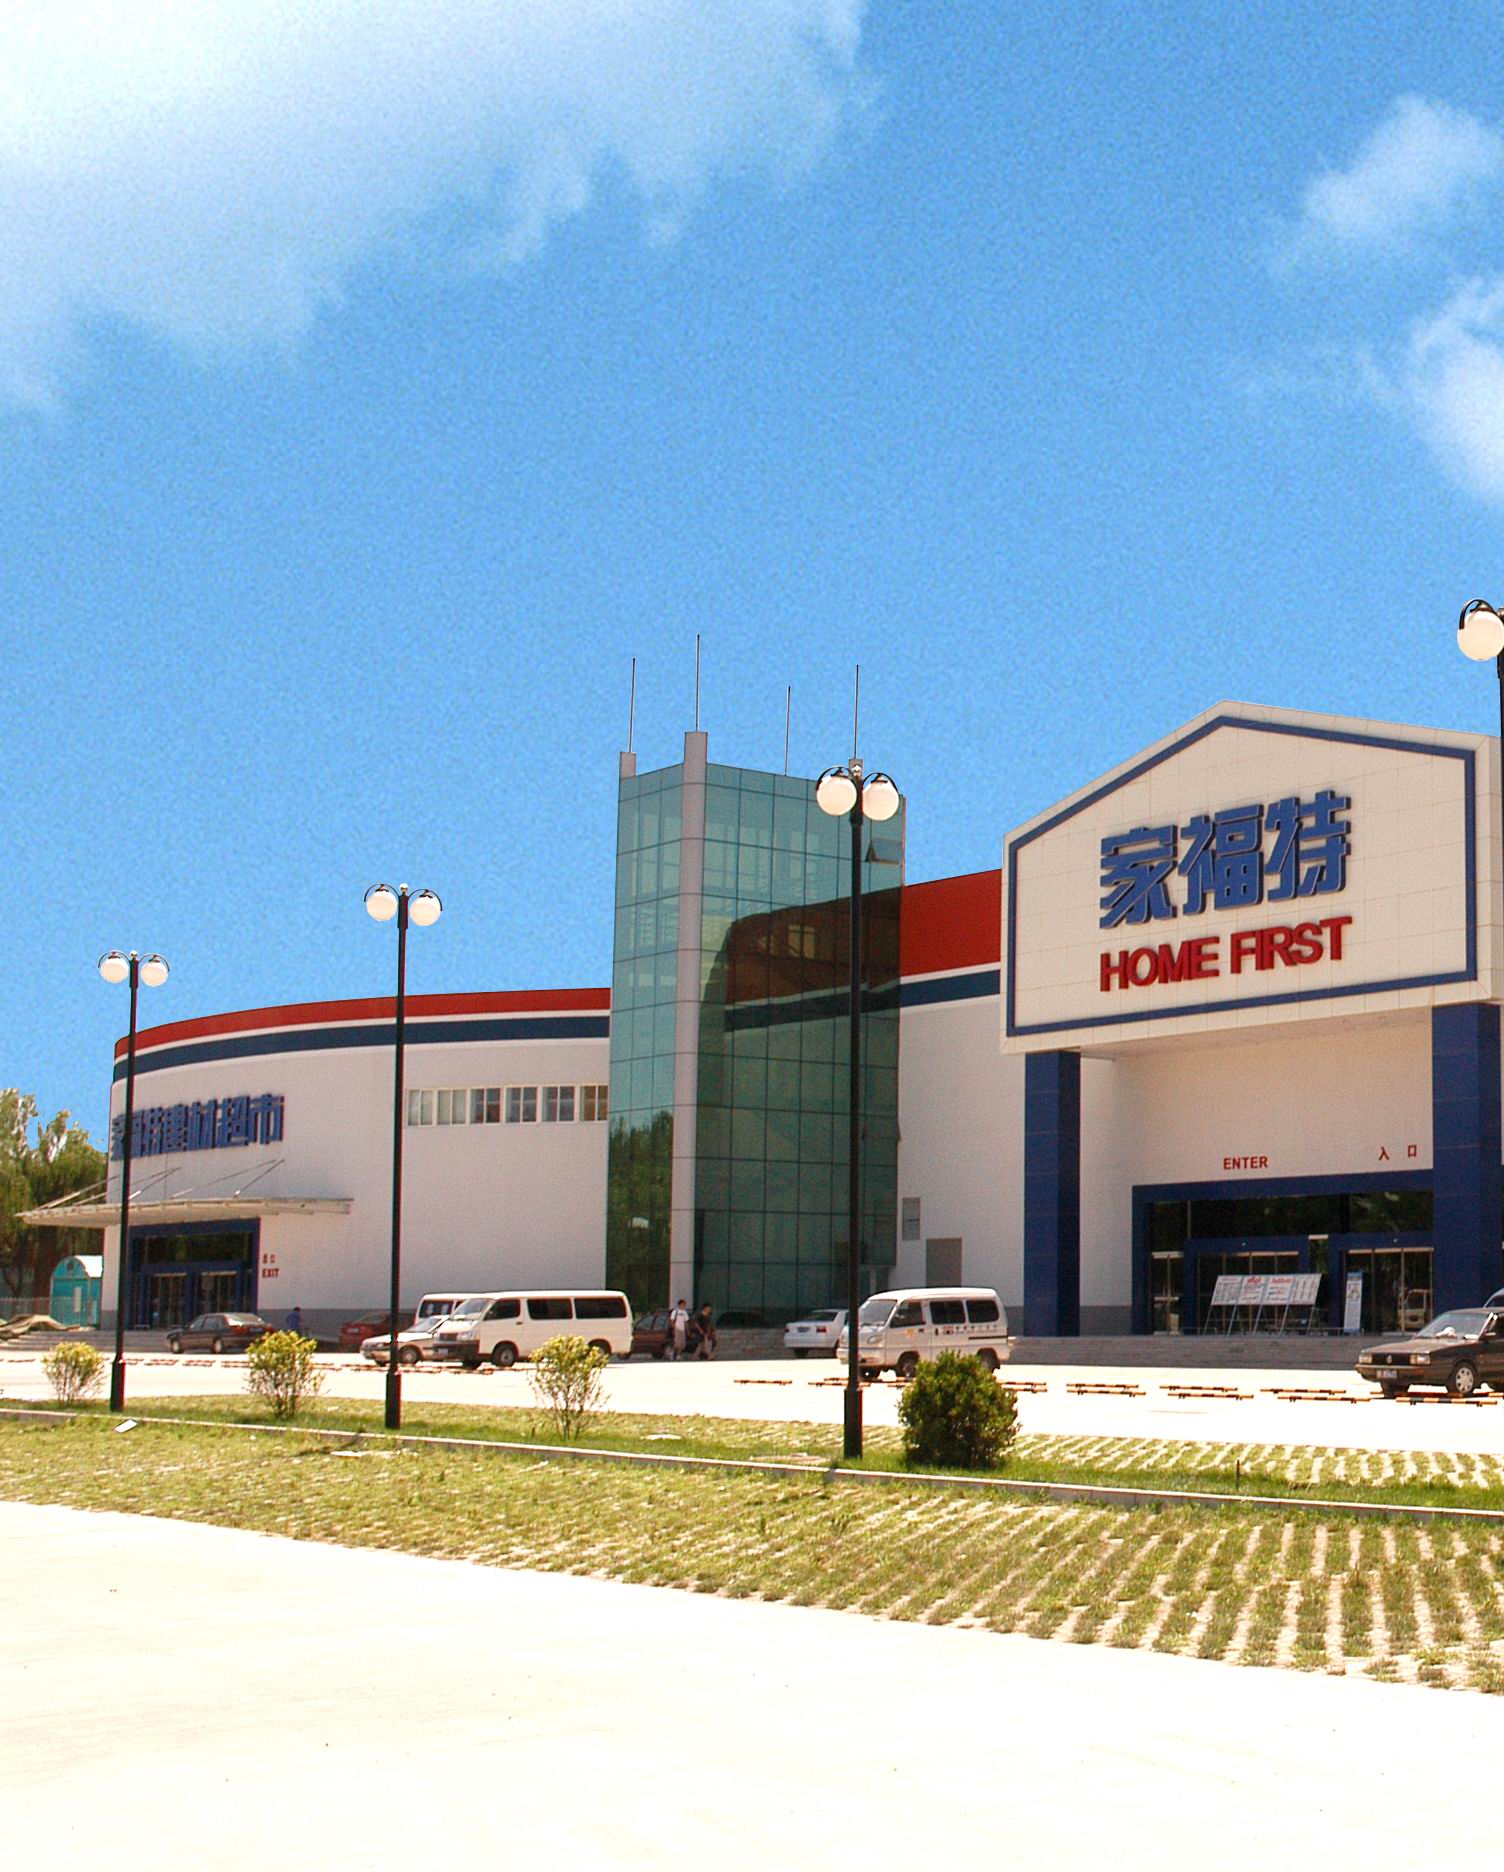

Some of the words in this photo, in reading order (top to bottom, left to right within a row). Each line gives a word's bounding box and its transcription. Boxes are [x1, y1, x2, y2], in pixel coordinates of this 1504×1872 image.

[1099, 788, 1352, 930] 家福特
[1099, 935, 1220, 993] HOME
[1230, 915, 1353, 976] FIRST
[1378, 1144, 1418, 1162] 入口
[1222, 1155, 1268, 1170] ENTER
[262, 1268, 280, 1279] EXIT
